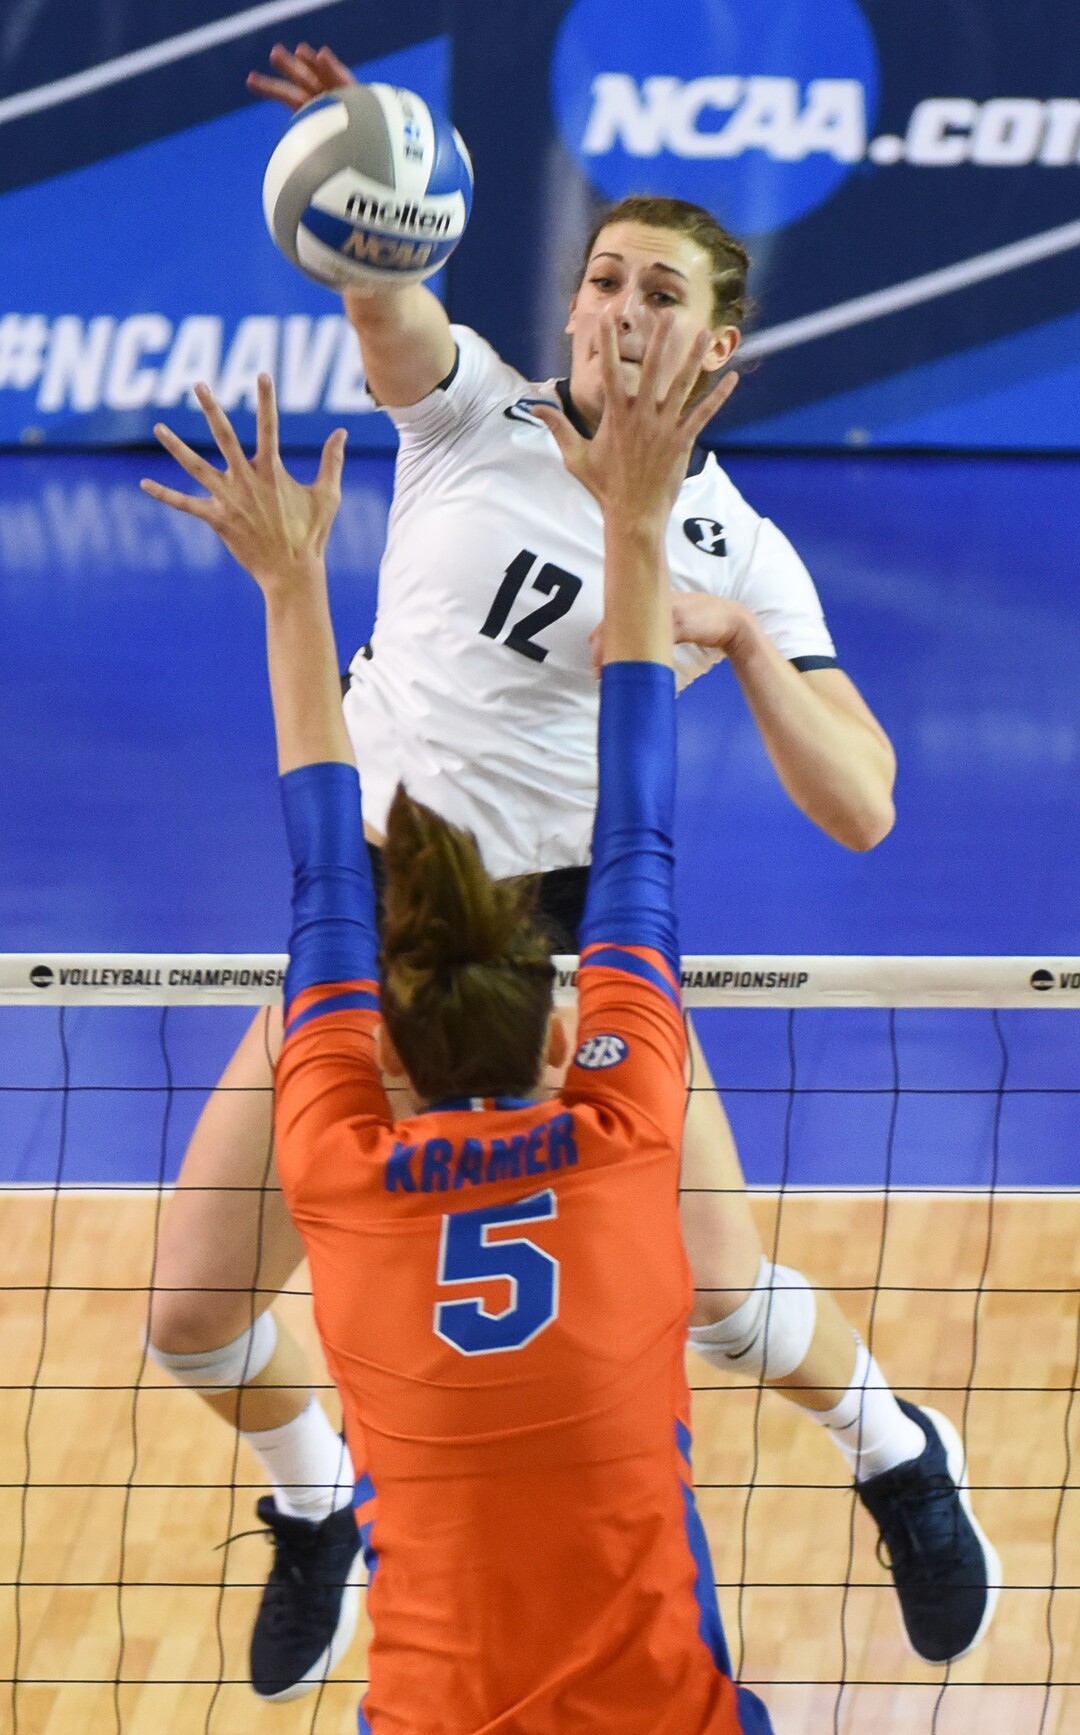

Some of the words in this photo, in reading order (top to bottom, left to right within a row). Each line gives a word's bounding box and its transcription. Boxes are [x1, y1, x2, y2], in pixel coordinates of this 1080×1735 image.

[344, 193, 453, 237] molten
[479, 548, 583, 664] 12
[59, 968, 162, 987] VOLLEYBALL
[168, 968, 286, 988] CHAMPIONSH
[680, 970, 809, 989] HAMPIONSHIP
[384, 1112, 579, 1194] KRAMER
[433, 1188, 560, 1357] 5
